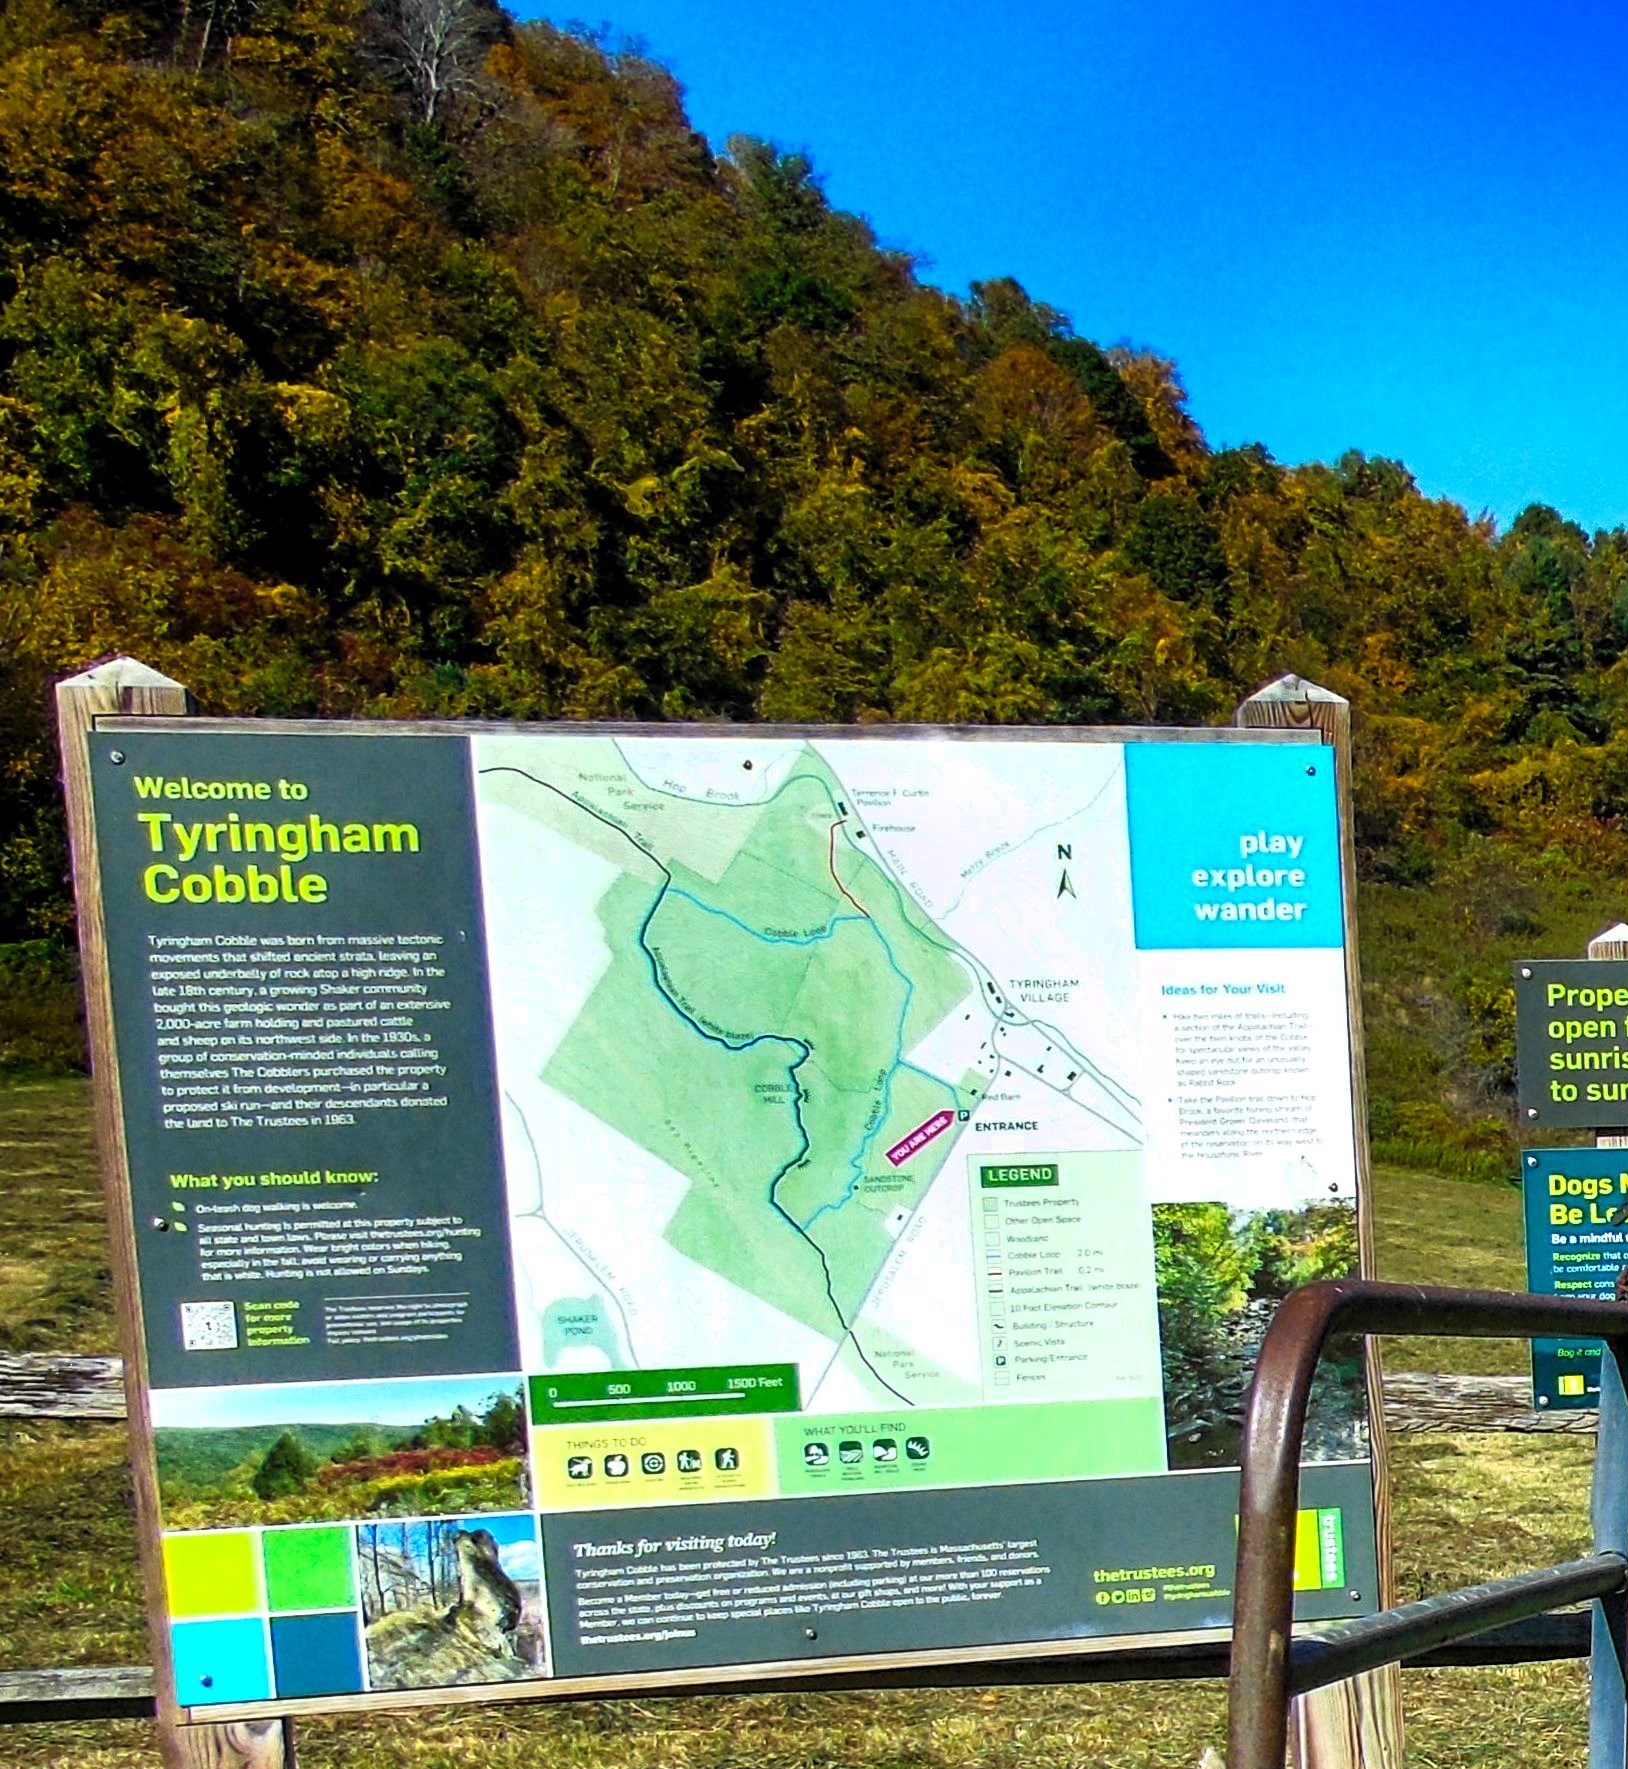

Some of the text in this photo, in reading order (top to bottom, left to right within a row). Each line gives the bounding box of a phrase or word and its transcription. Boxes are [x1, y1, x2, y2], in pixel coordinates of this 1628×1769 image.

[134, 776, 307, 800] Welcome to
[137, 812, 420, 861] Tyringham
[1239, 830, 1302, 858] play
[1057, 844, 1072, 860] N
[144, 864, 328, 903] Cobble
[1191, 864, 1304, 891] explore
[1194, 898, 1305, 920] wander
[1010, 979, 1079, 988] TYRINGHAM
[1161, 983, 1285, 995] Ideas for Your Visit
[1020, 992, 1069, 1002] VILLAGE
[1548, 1020, 1615, 1043] open
[1550, 1080, 1577, 1101] to
[975, 1121, 1038, 1131] ENTRANCE
[891, 1116, 948, 1159] YOU ARE HERE
[170, 1170, 378, 1189] What you should know:
[988, 1167, 1051, 1181] LEGEND
[1548, 1174, 1612, 1199] Dogs
[1549, 1203, 1582, 1224] Be
[1551, 1233, 1567, 1244] Be
[1569, 1235, 1577, 1244] a
[1579, 1232, 1623, 1243] mindful
[1553, 1252, 1601, 1263] Recognize
[1603, 1251, 1622, 1260] that
[1553, 1265, 1565, 1273] be
[1566, 1263, 1619, 1272] comfortable
[1554, 1280, 1593, 1290] Respect
[243, 1300, 299, 1310] Scan code
[244, 1313, 261, 1322] for
[246, 1325, 293, 1336] property
[565, 1327, 594, 1336] POND
[247, 1336, 310, 1346] information
[607, 1383, 631, 1394] 500
[667, 1380, 696, 1392] 1000
[727, 1377, 782, 1389] 1500 Feet
[548, 1387, 557, 1398] 0
[803, 1422, 905, 1436] WHAT YOU'LL FIND
[566, 1436, 645, 1449] THINGS TO DO
[573, 1532, 776, 1557] Thanks for visiting today!
[1323, 1515, 1338, 1582] trustees
[1093, 1564, 1215, 1584] thetrustees.org
